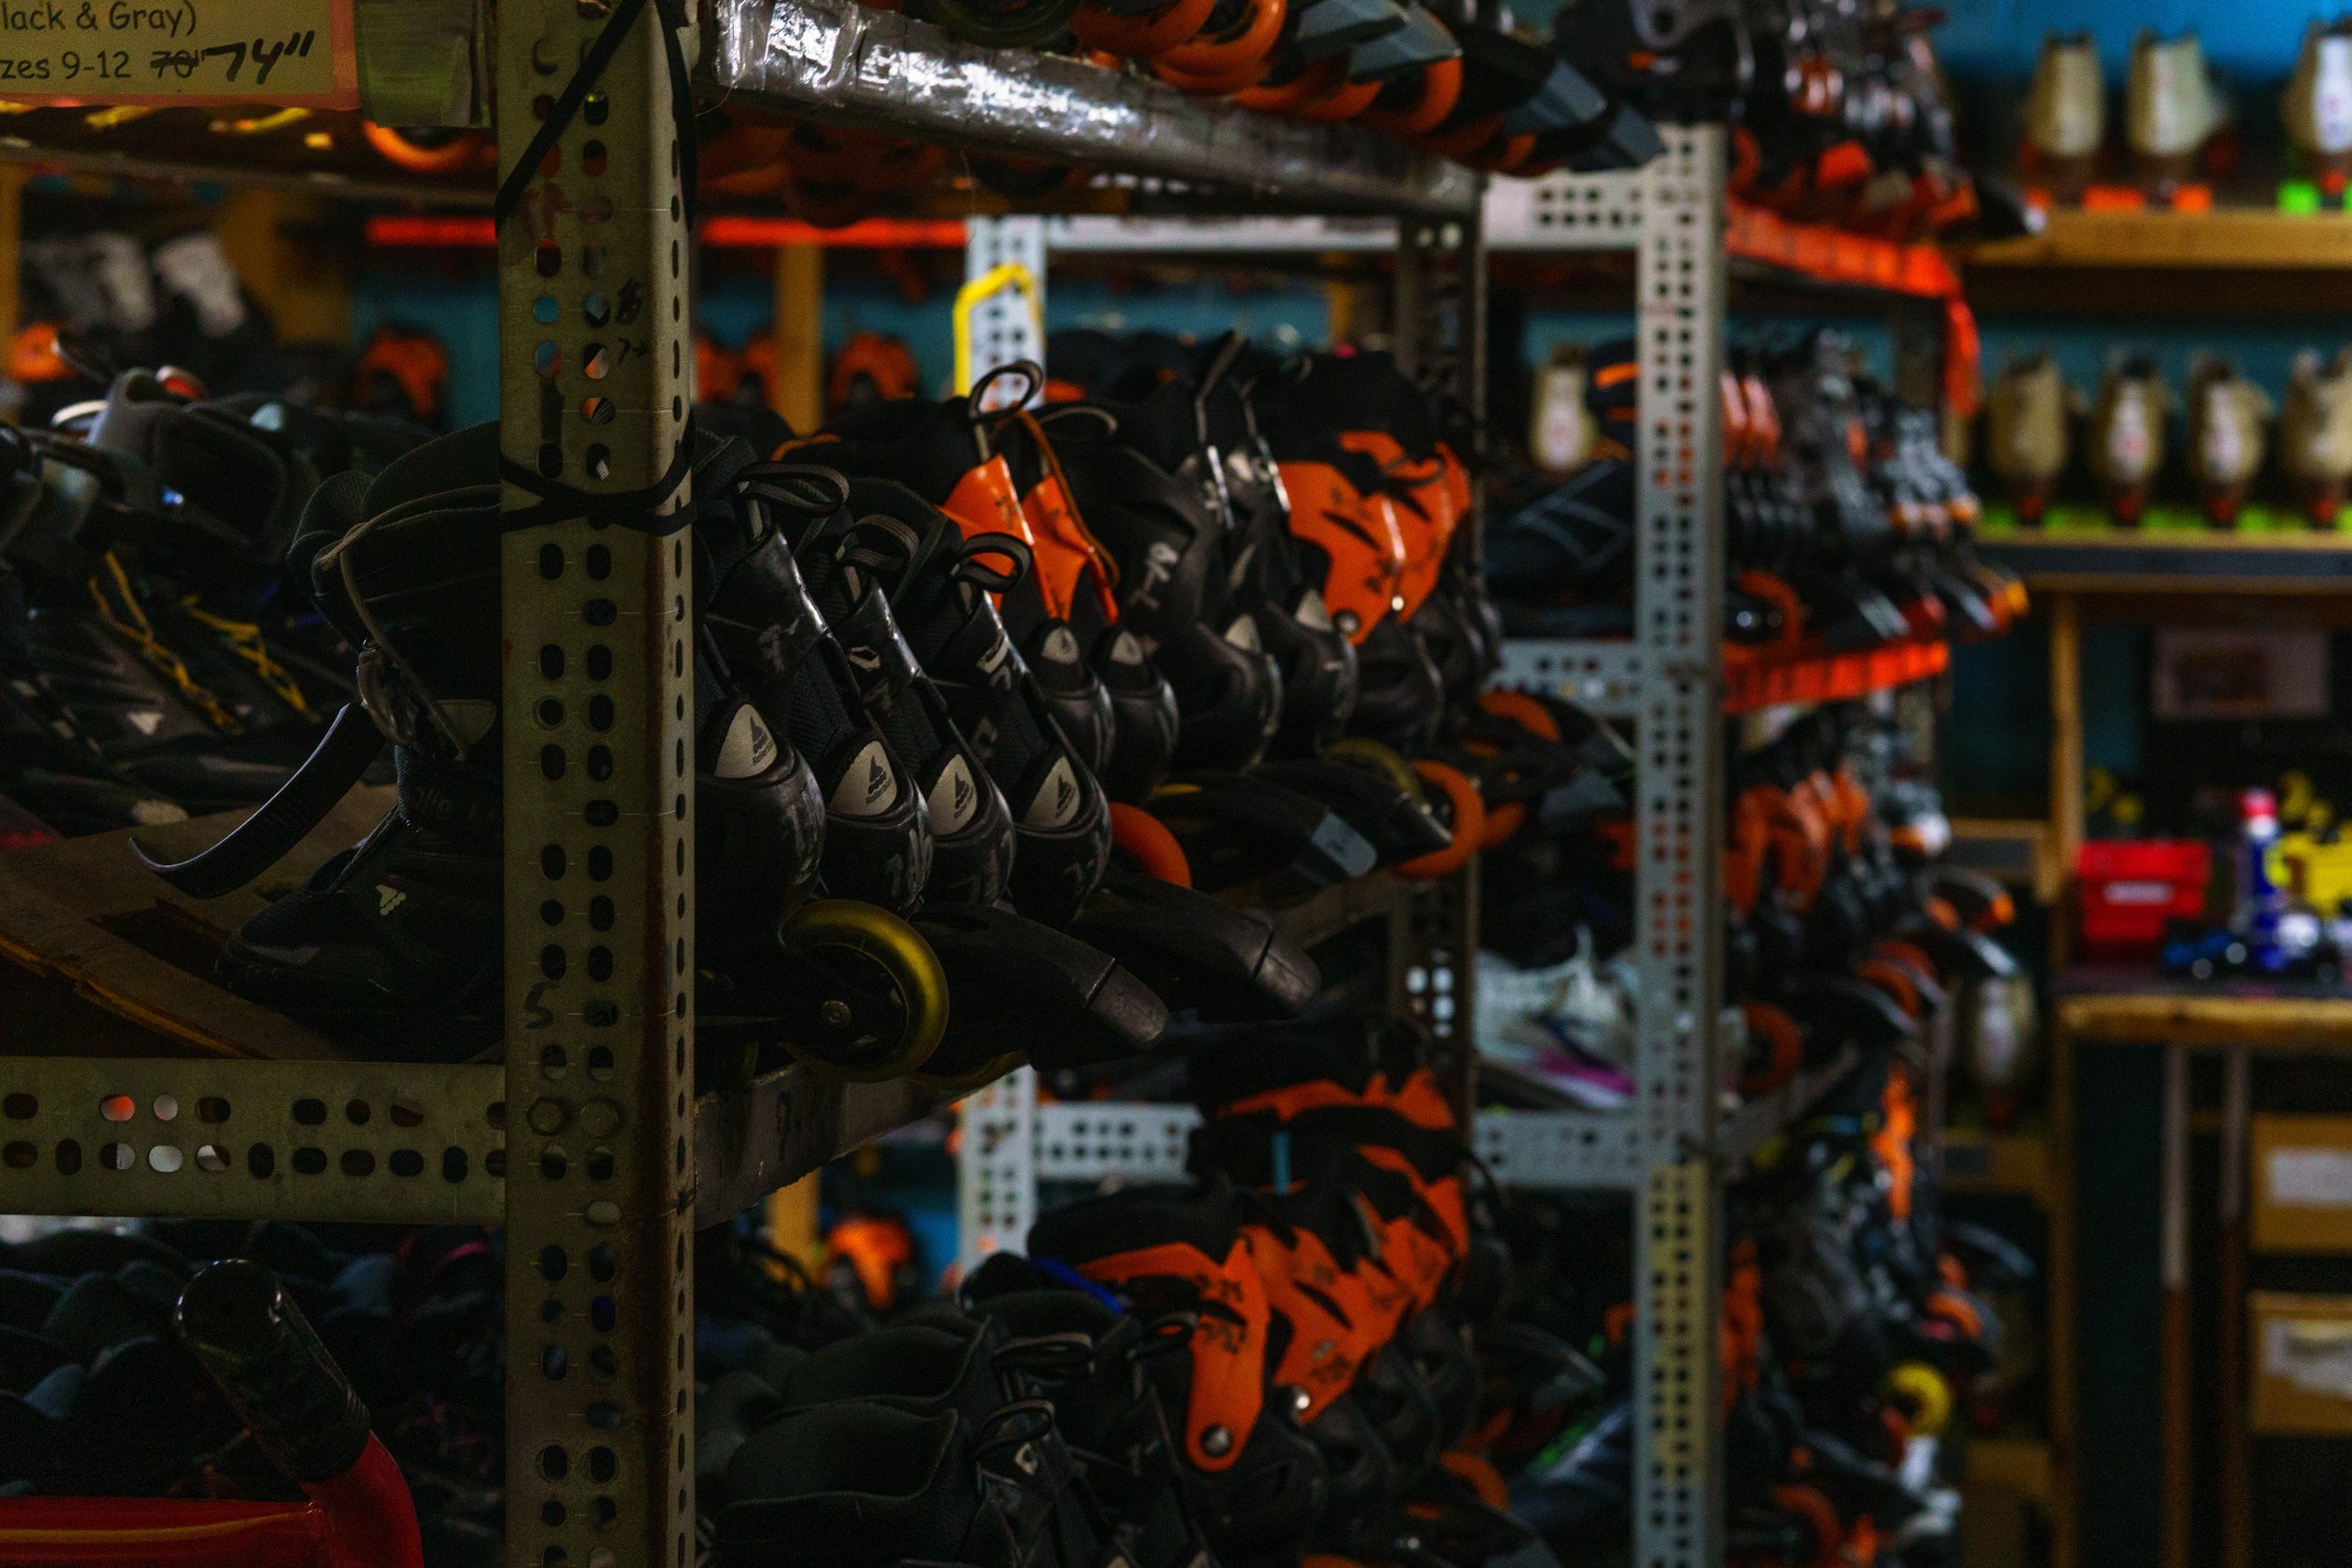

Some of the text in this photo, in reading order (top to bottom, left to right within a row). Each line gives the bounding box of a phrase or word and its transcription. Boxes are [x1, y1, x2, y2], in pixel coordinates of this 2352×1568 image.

[75, 1, 98, 31] &
[109, 0, 197, 39] Gray)
[0, 57, 50, 80] zes
[62, 50, 132, 80] 9-12
